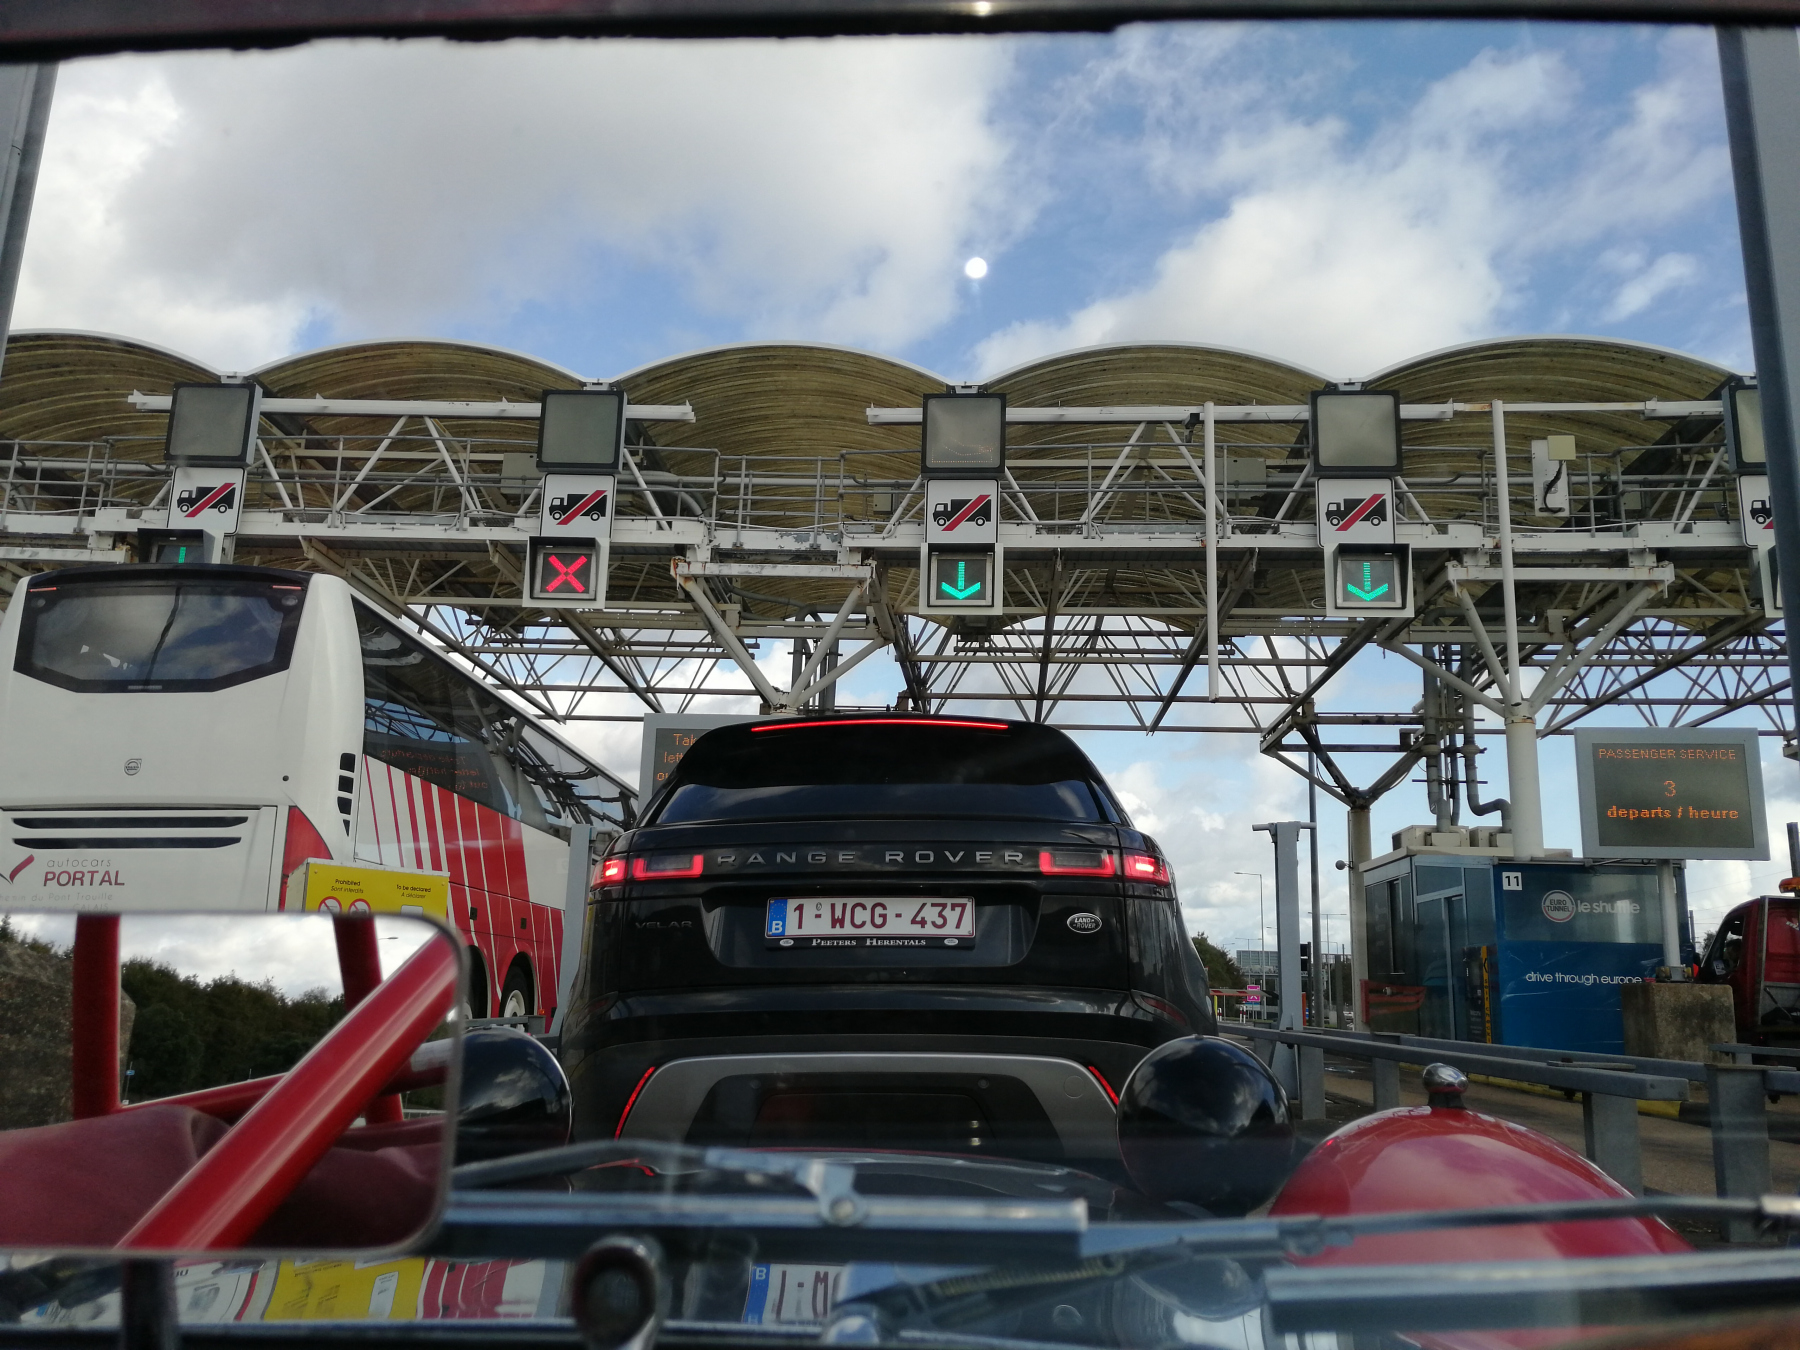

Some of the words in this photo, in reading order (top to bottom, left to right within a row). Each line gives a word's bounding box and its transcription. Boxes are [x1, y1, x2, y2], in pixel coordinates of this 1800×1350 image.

[1598, 748, 1676, 759] PASSENGER
[1679, 749, 1736, 760] SERVICE
[1663, 780, 1677, 797] 3
[1607, 805, 1672, 820] departs
[1688, 806, 1739, 819] heure
[46, 858, 111, 867] autocars
[717, 851, 856, 867] RANGE
[885, 850, 1024, 865] ROVER
[43, 870, 125, 886] PORTAL
[335, 878, 361, 886] Prohibited
[1504, 875, 1520, 887] 11
[31, 893, 44, 902] du
[48, 893, 71, 901] Pont
[76, 892, 113, 901] Trouille
[1578, 900, 1591, 913] le
[794, 902, 968, 929] 1-WCG-437
[635, 920, 693, 929] VELAR
[771, 920, 783, 933] B
[811, 938, 857, 946] PEETERS
[865, 937, 926, 946] HERENTALS
[1525, 971, 1553, 983] drive
[1555, 972, 1600, 986] through
